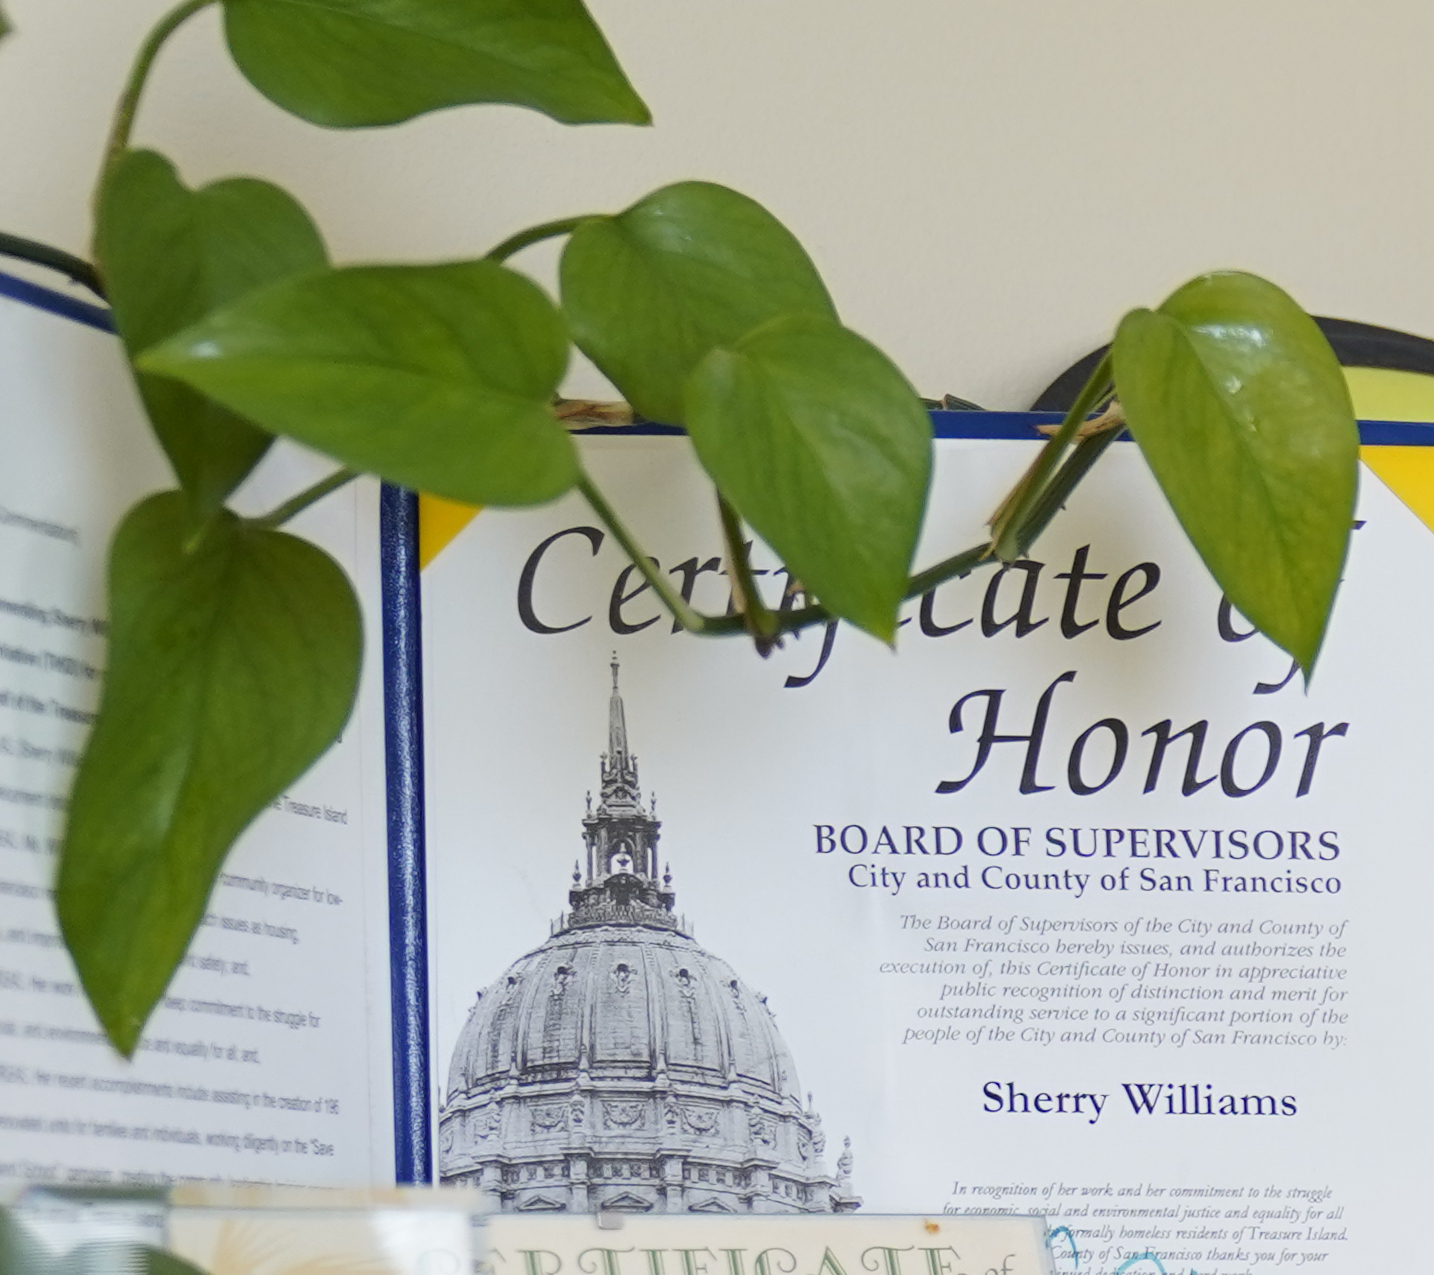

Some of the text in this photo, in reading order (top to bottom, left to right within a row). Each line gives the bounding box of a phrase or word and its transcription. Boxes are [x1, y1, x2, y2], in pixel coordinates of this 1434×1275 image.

[935, 670, 1350, 799] Honor
[814, 824, 1341, 862] BOARD OF SUPERVISORS
[849, 864, 1340, 897] City and County of San Francisco
[900, 914, 1323, 938] The Board Supervisors the City and County
[924, 937, 1346, 957] San Francisco hereby issues, and authorizes the
[879, 959, 1346, 982] execution of, this Certificate Honor appreciative
[939, 981, 1348, 1005] public recognition distinction and merit for
[917, 1003, 1348, 1026] outstanding service significant portion the
[901, 1025, 1346, 1049] people the City and County San Francisco by:
[983, 1081, 1297, 1123] Sherry Williams
[971, 1182, 1332, 1202] recognition her work and her commitment the struggle
[1062, 1203, 1300, 1222] and environmental equality
[1118, 1225, 1302, 1240] homeless residents Treasure
[1206, 1247, 1250, 1262] thanks
